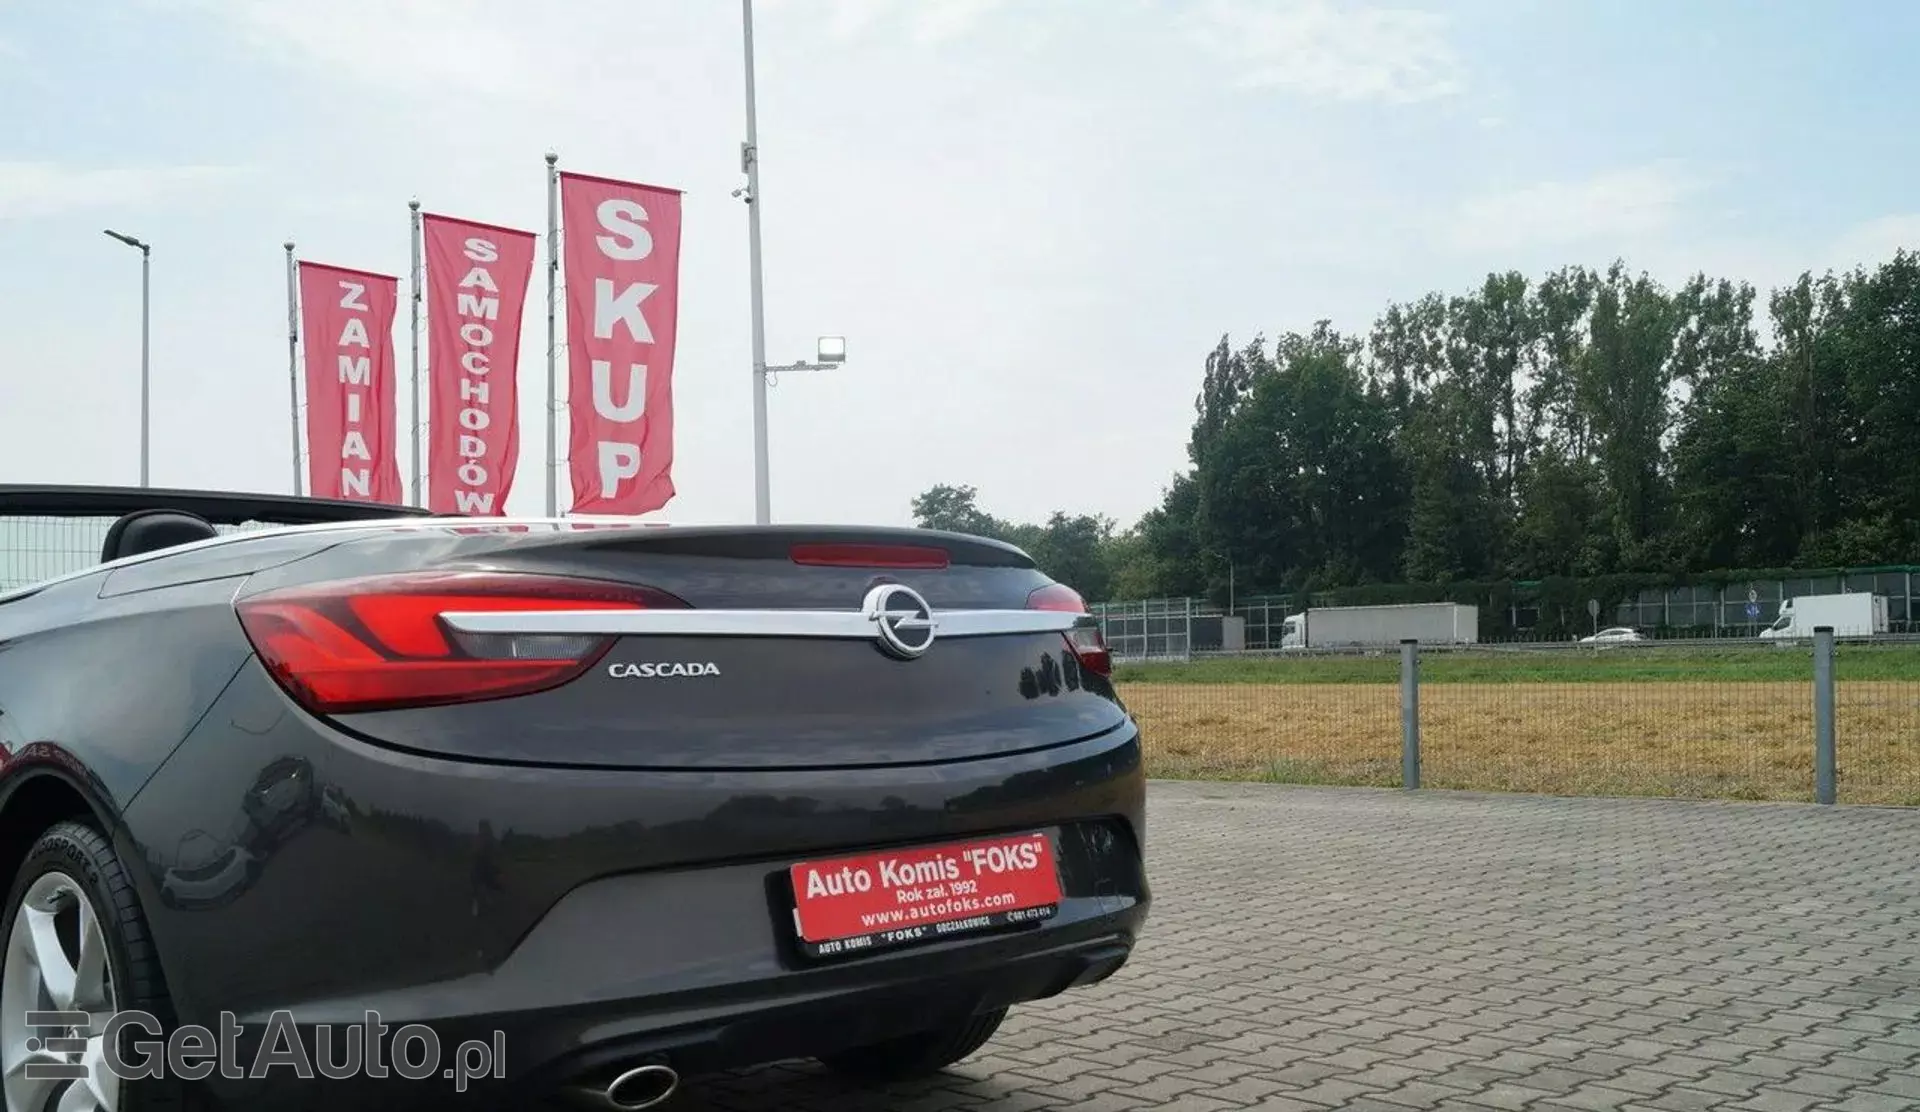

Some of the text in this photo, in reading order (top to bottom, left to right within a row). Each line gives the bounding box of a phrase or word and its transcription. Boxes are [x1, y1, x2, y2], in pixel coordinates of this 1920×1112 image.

[591, 199, 659, 499] SKUP
[338, 280, 371, 497] ZAMIAN
[455, 238, 499, 514] SAMOCHODÓW
[608, 662, 720, 677] CASCADA
[807, 841, 1043, 899] Auto Komis "FOKS"
[896, 879, 978, 903] Rok zał. 1992
[861, 892, 1016, 926] www.autofoks.com
[819, 941, 842, 954] AUTO
[844, 936, 872, 950] KOMIS
[881, 926, 928, 942] "FOKS"
